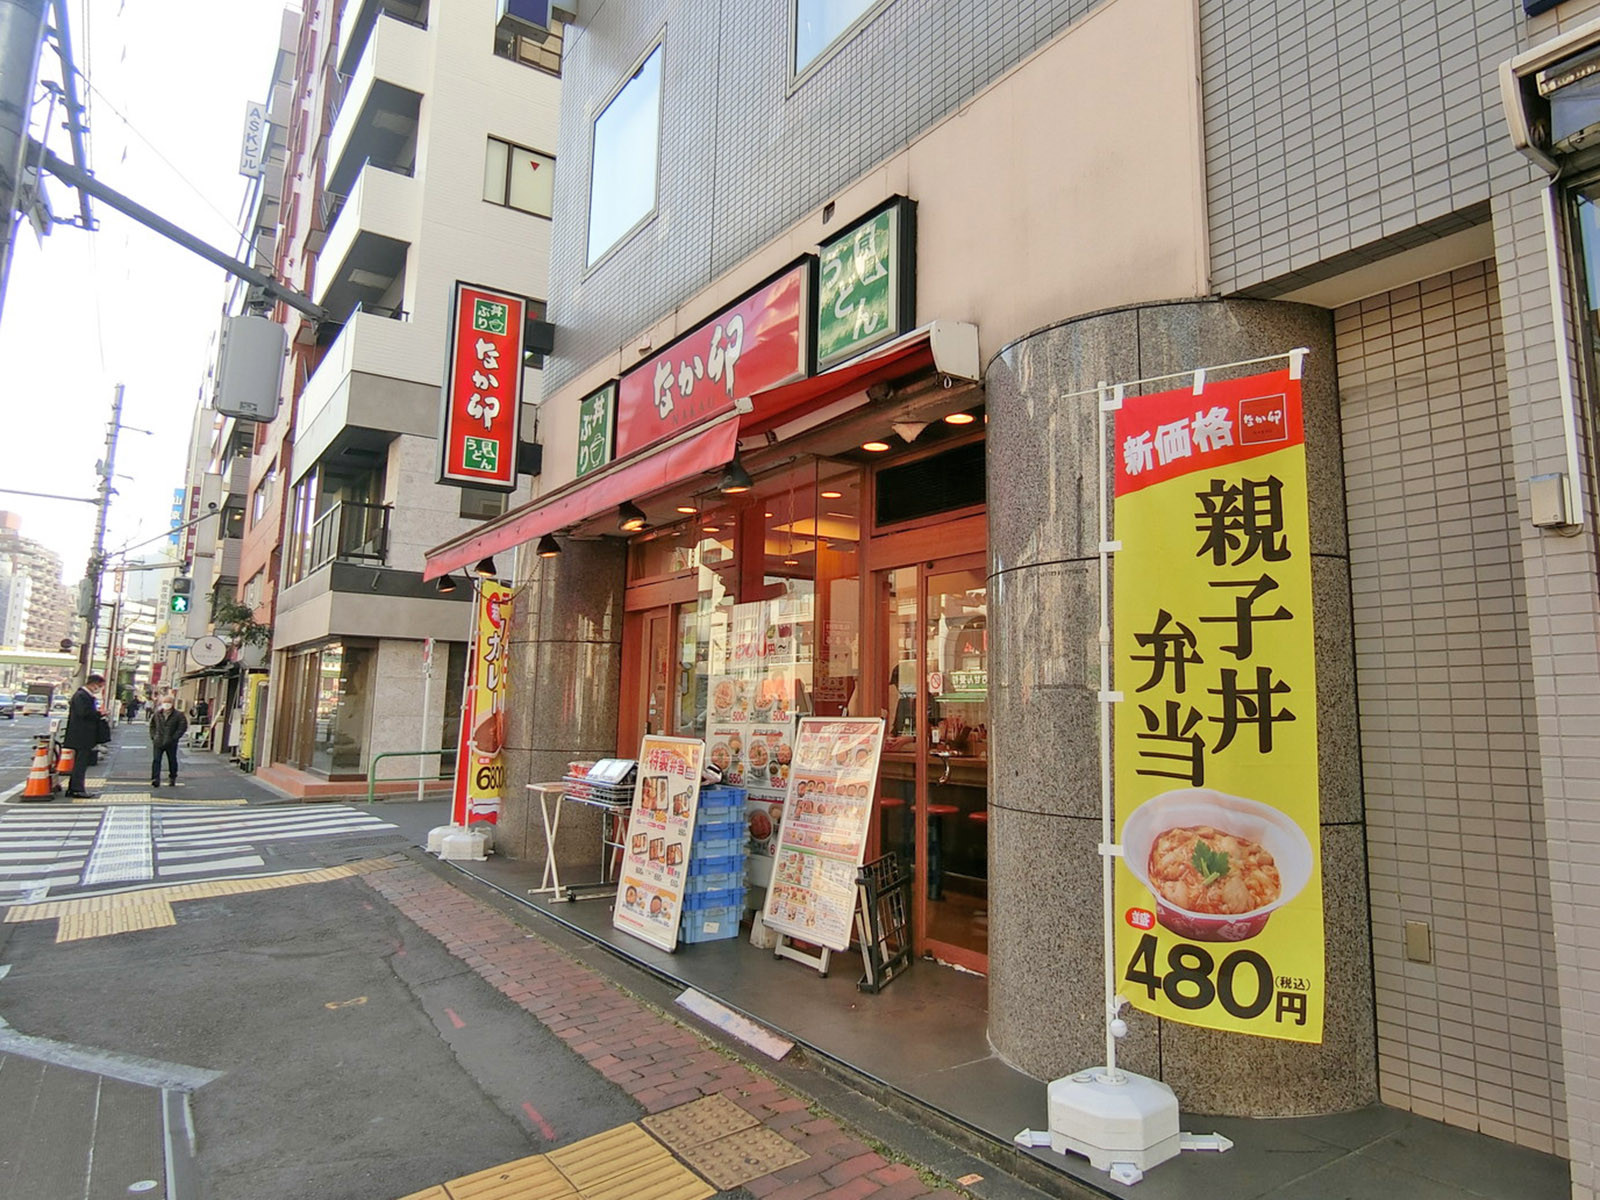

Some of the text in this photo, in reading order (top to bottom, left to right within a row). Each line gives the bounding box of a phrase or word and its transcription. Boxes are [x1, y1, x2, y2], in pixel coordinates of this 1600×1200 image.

[242, 107, 261, 169] ASKビル
[467, 337, 500, 432] なか卯
[653, 313, 744, 420] なか卯
[1123, 406, 1235, 476] 新価格
[1243, 409, 1282, 428] なか卯
[1194, 474, 1297, 754] 親子丼
[1130, 608, 1207, 787] 弁当
